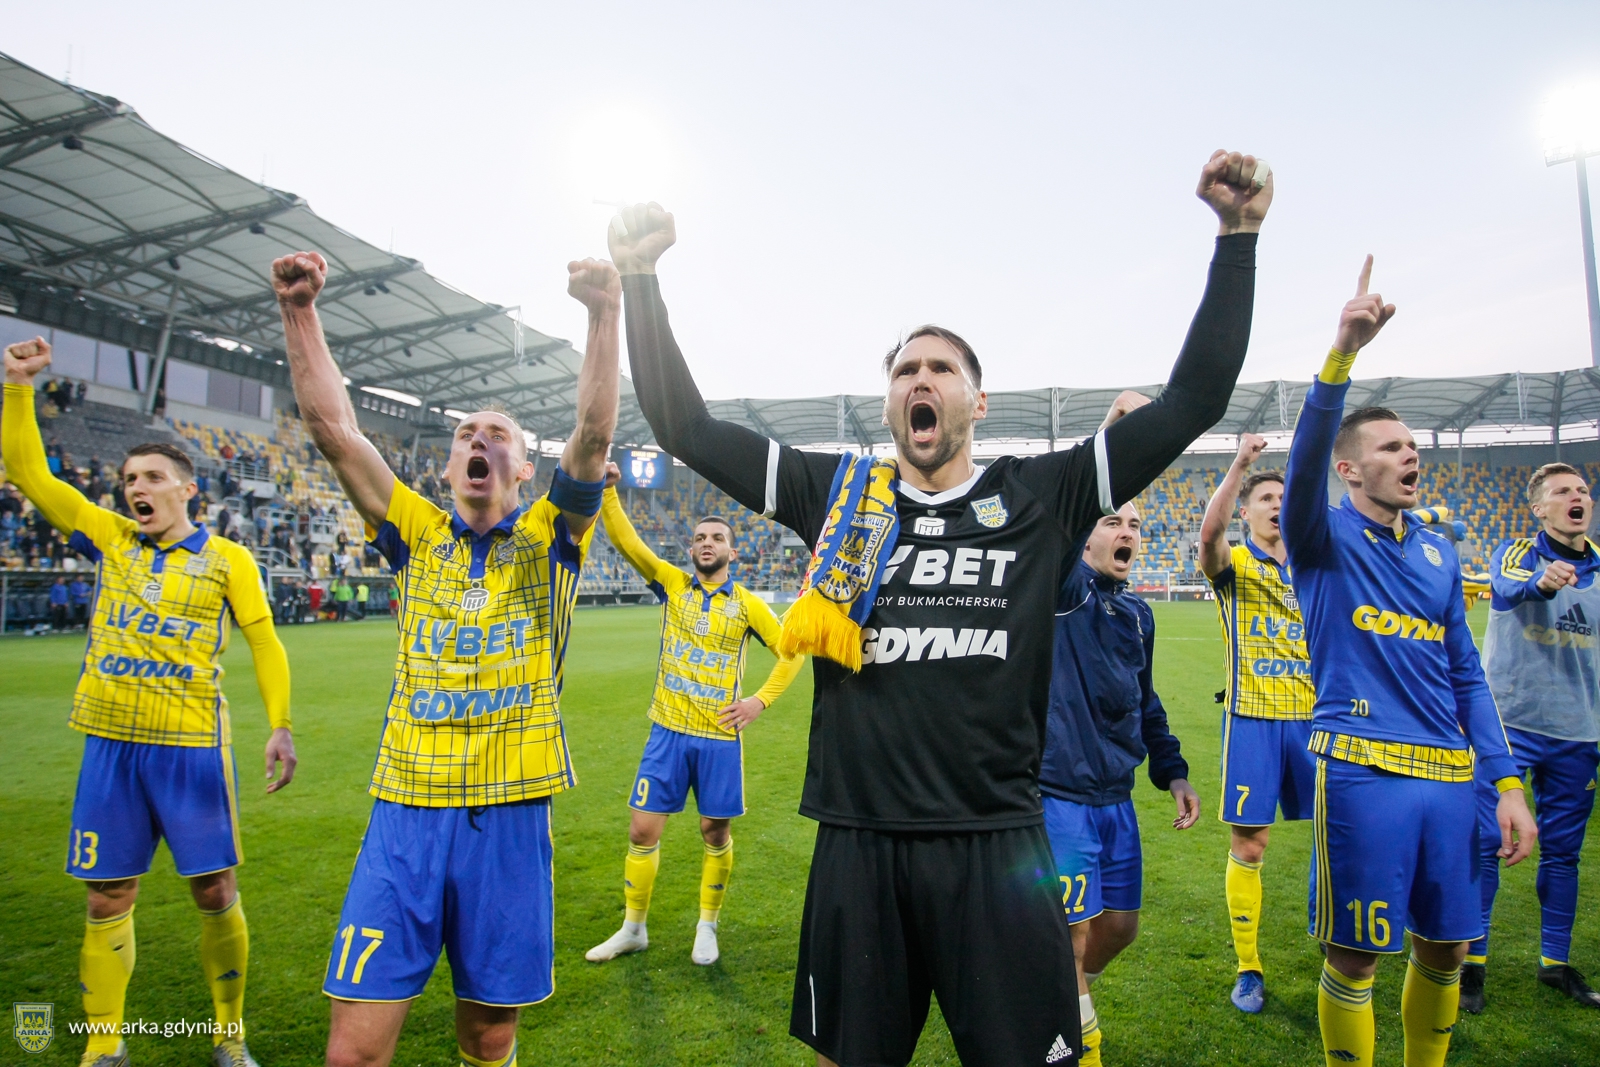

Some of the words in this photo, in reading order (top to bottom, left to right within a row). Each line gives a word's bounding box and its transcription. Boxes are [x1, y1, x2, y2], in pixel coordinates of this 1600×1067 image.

[832, 556, 861, 578] RKA
[897, 596, 1008, 609] BUKMACHERSKIE
[1249, 615, 1304, 641] LVB
[1352, 605, 1446, 643] GDYNI
[861, 627, 1008, 665] GDYNIA
[98, 653, 194, 680] GDYNIA
[1253, 658, 1311, 677] GDYN
[664, 673, 727, 701] GDYNIA
[409, 683, 532, 721] GDYNIA
[1350, 699, 1369, 716] 20
[635, 778, 650, 807] 9
[1236, 785, 1250, 816] 7
[1059, 874, 1087, 915] 22
[1346, 898, 1390, 947] 16
[336, 924, 384, 984] 17
[1046, 1047, 1073, 1064] adidas
